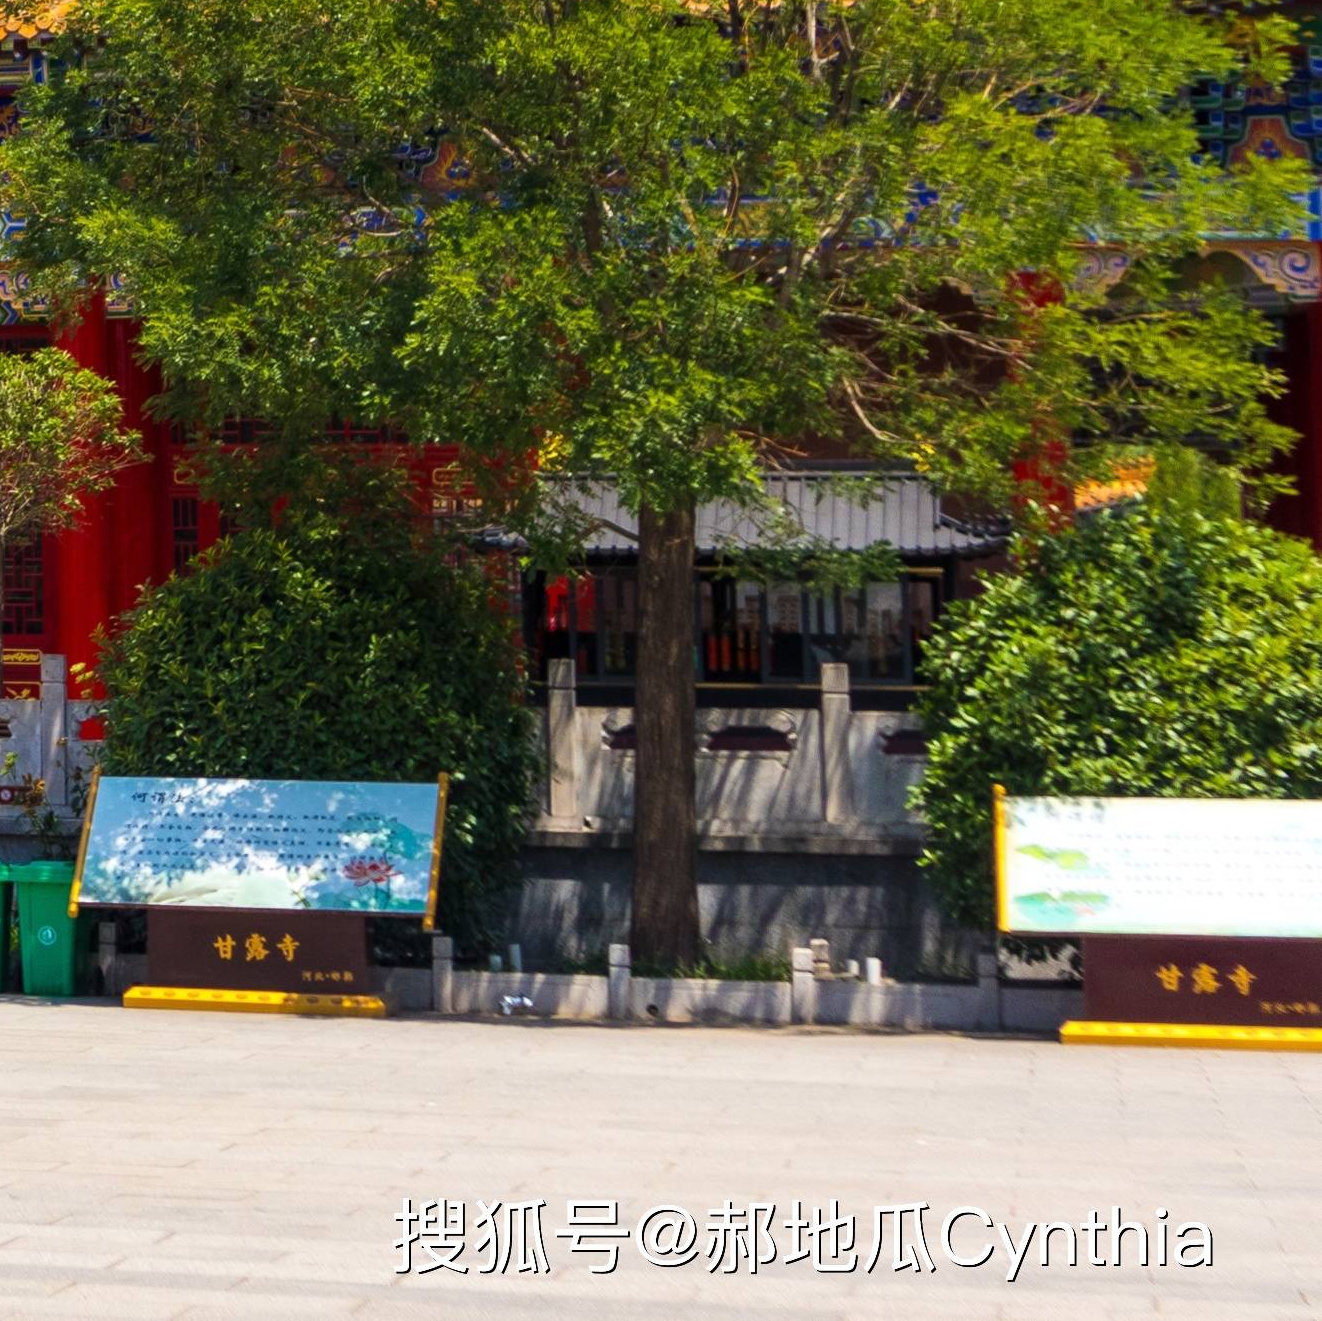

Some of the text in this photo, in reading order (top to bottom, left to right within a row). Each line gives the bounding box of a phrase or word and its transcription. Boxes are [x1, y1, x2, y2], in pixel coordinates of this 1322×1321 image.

[213, 933, 300, 962] 甘露寺
[1155, 962, 1258, 996] 甘露寺
